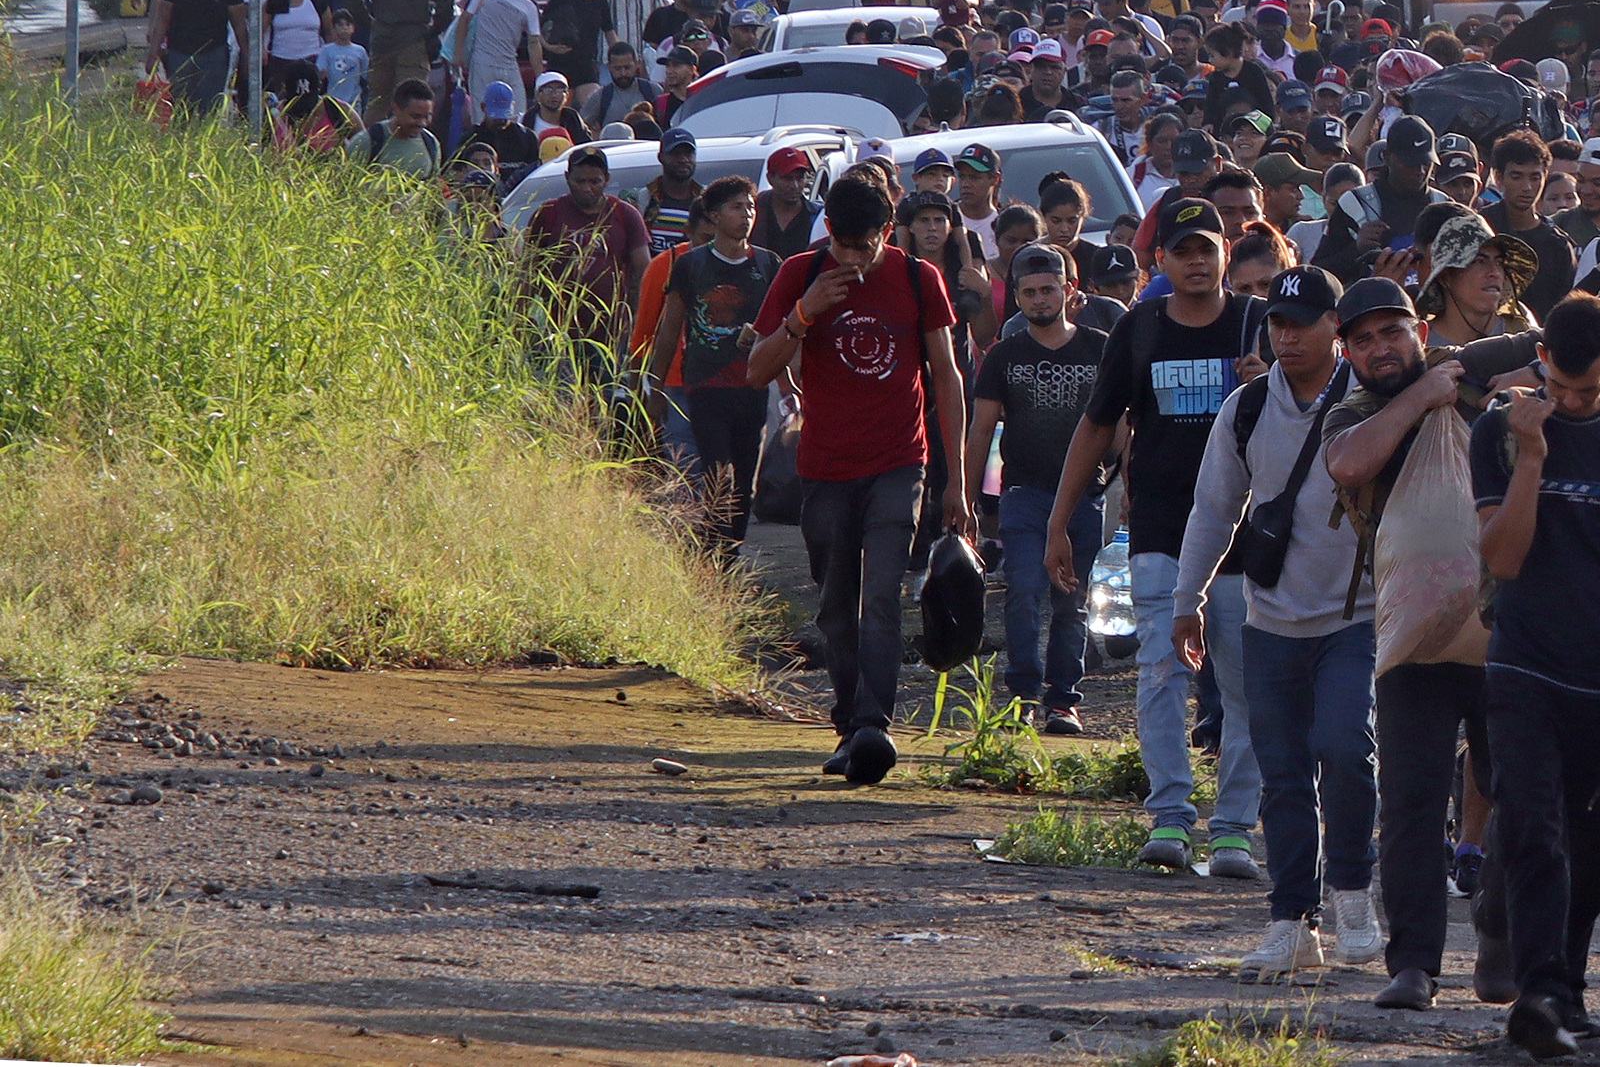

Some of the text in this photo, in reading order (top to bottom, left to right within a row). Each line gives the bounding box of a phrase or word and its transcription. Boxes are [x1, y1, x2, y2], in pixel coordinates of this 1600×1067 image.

[1280, 274, 1301, 297] NY
[845, 317, 876, 325] TOMMY
[855, 365, 884, 374] TOMMY
[1151, 357, 1223, 390] NEVER
